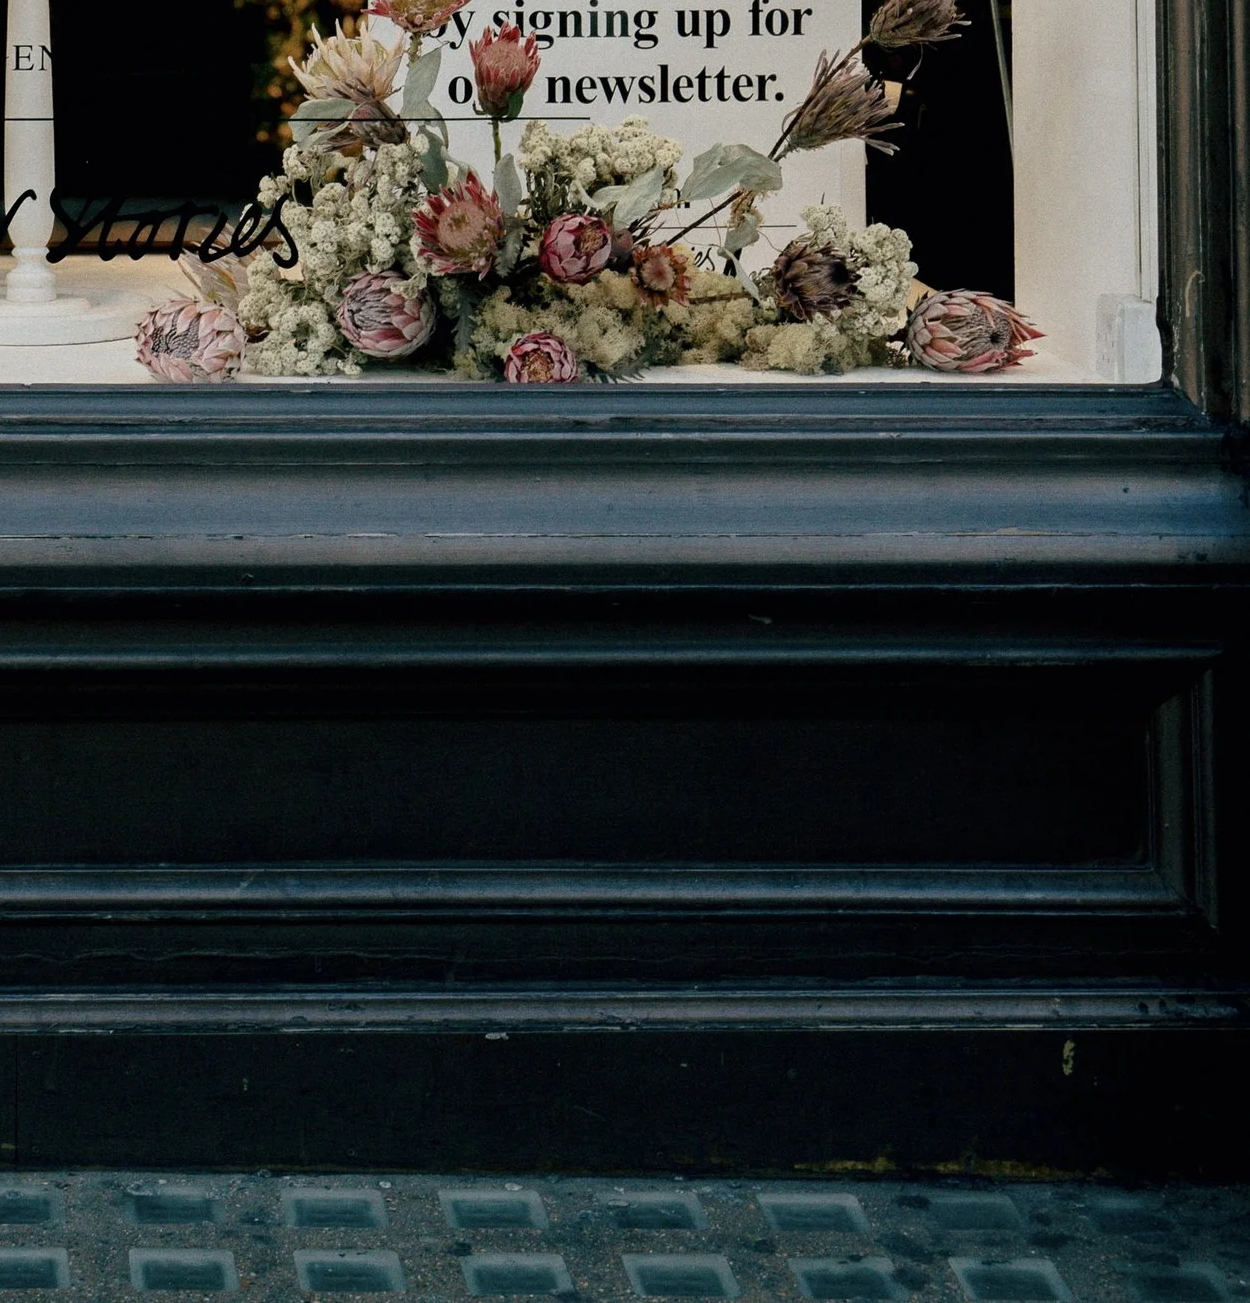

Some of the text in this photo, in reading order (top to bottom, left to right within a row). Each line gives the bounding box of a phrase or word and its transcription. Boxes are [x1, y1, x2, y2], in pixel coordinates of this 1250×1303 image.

[676, 9, 731, 49] up
[545, 64, 784, 104] newsletter.
[46, 187, 299, 269] Stories
